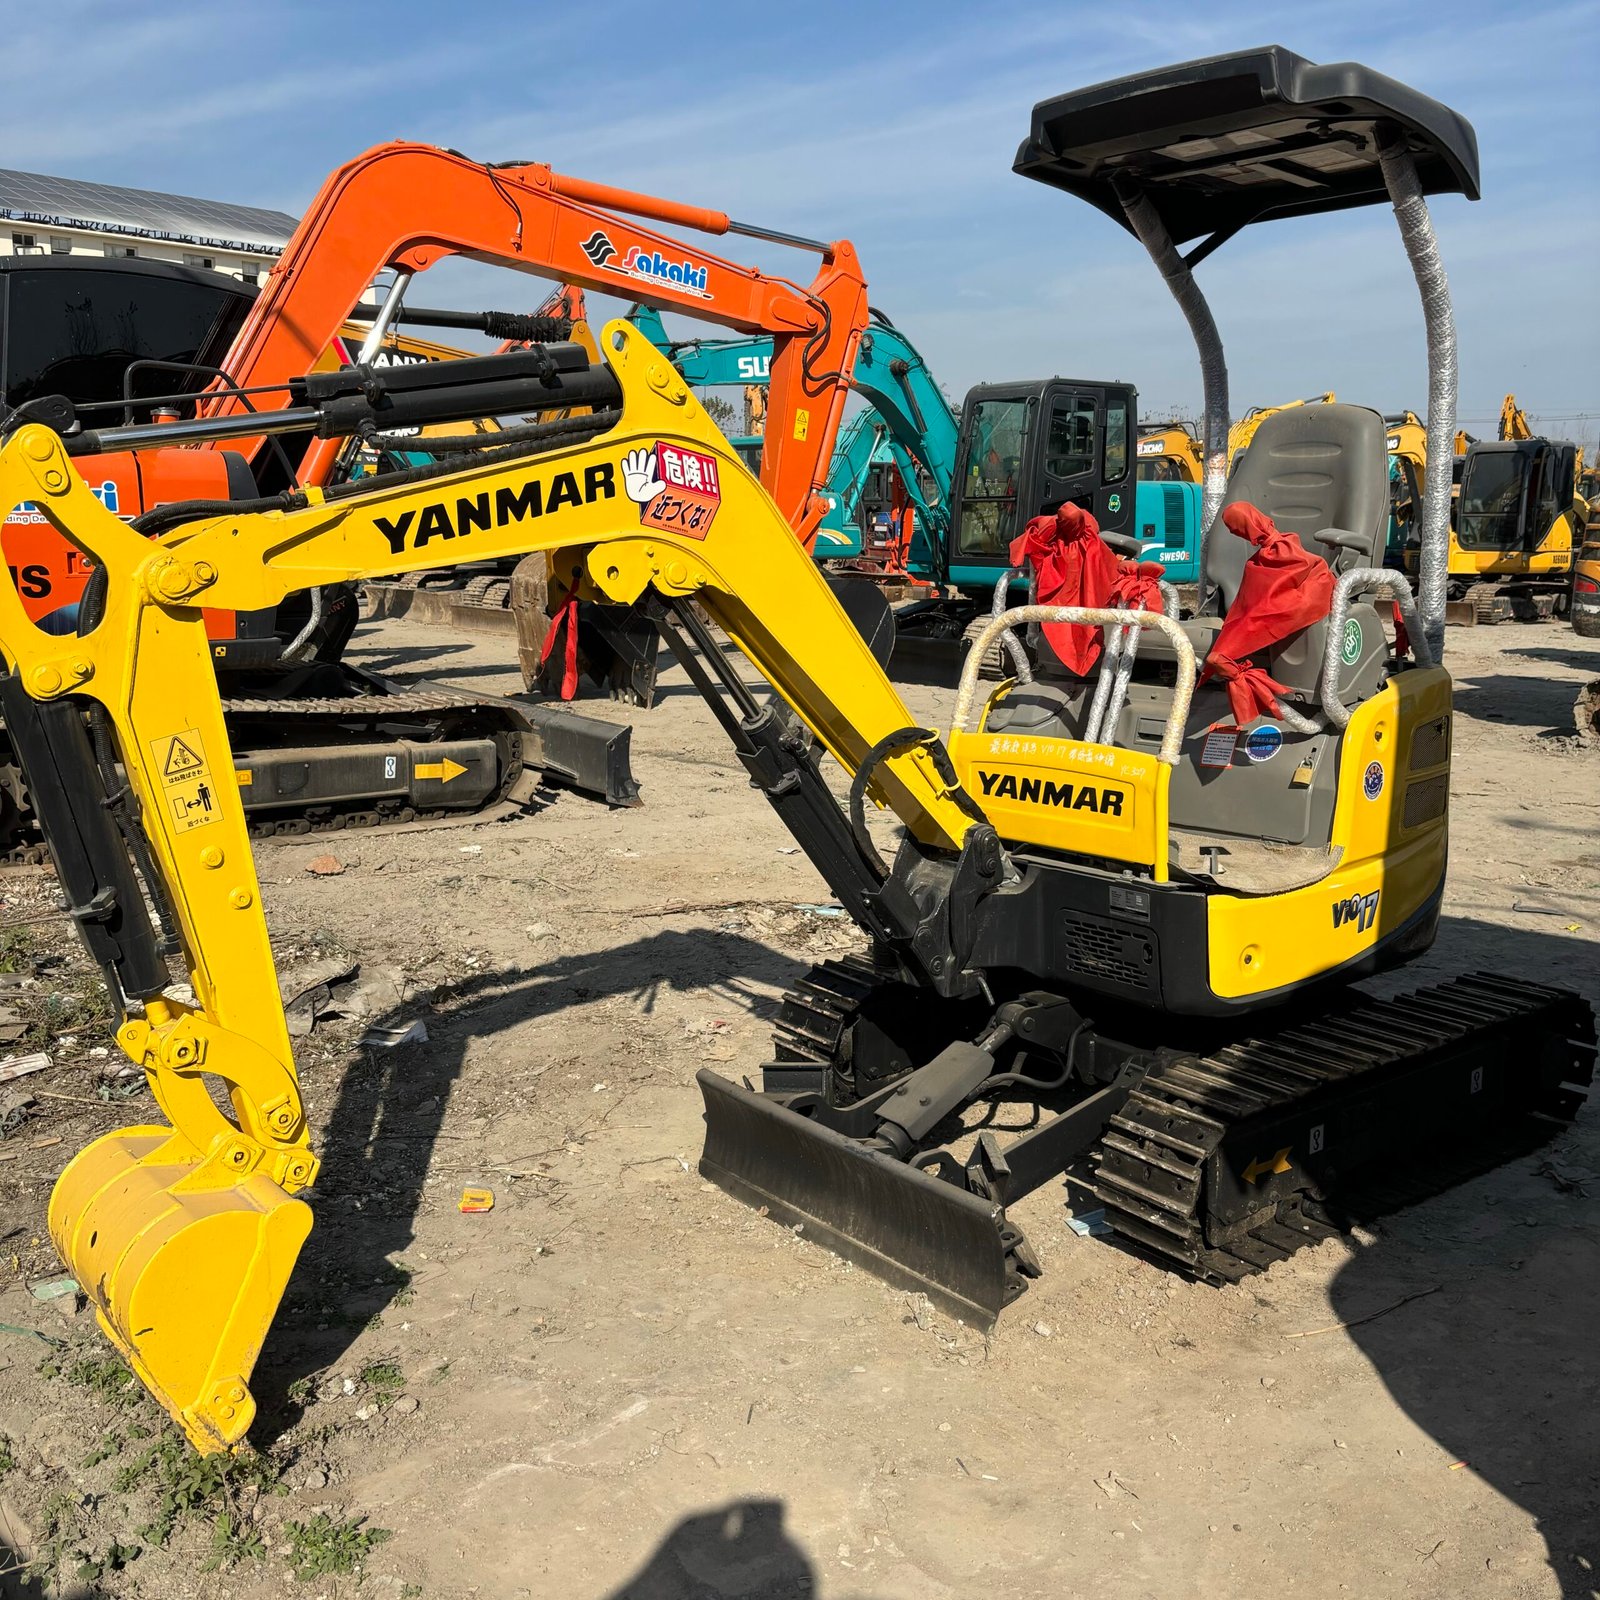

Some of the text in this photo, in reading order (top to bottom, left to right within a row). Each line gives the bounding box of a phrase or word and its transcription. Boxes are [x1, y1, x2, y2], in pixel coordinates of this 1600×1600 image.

[622, 246, 707, 291] Sakaki
[372, 462, 616, 555] YANMAR
[978, 771, 1124, 816] YANMAR
